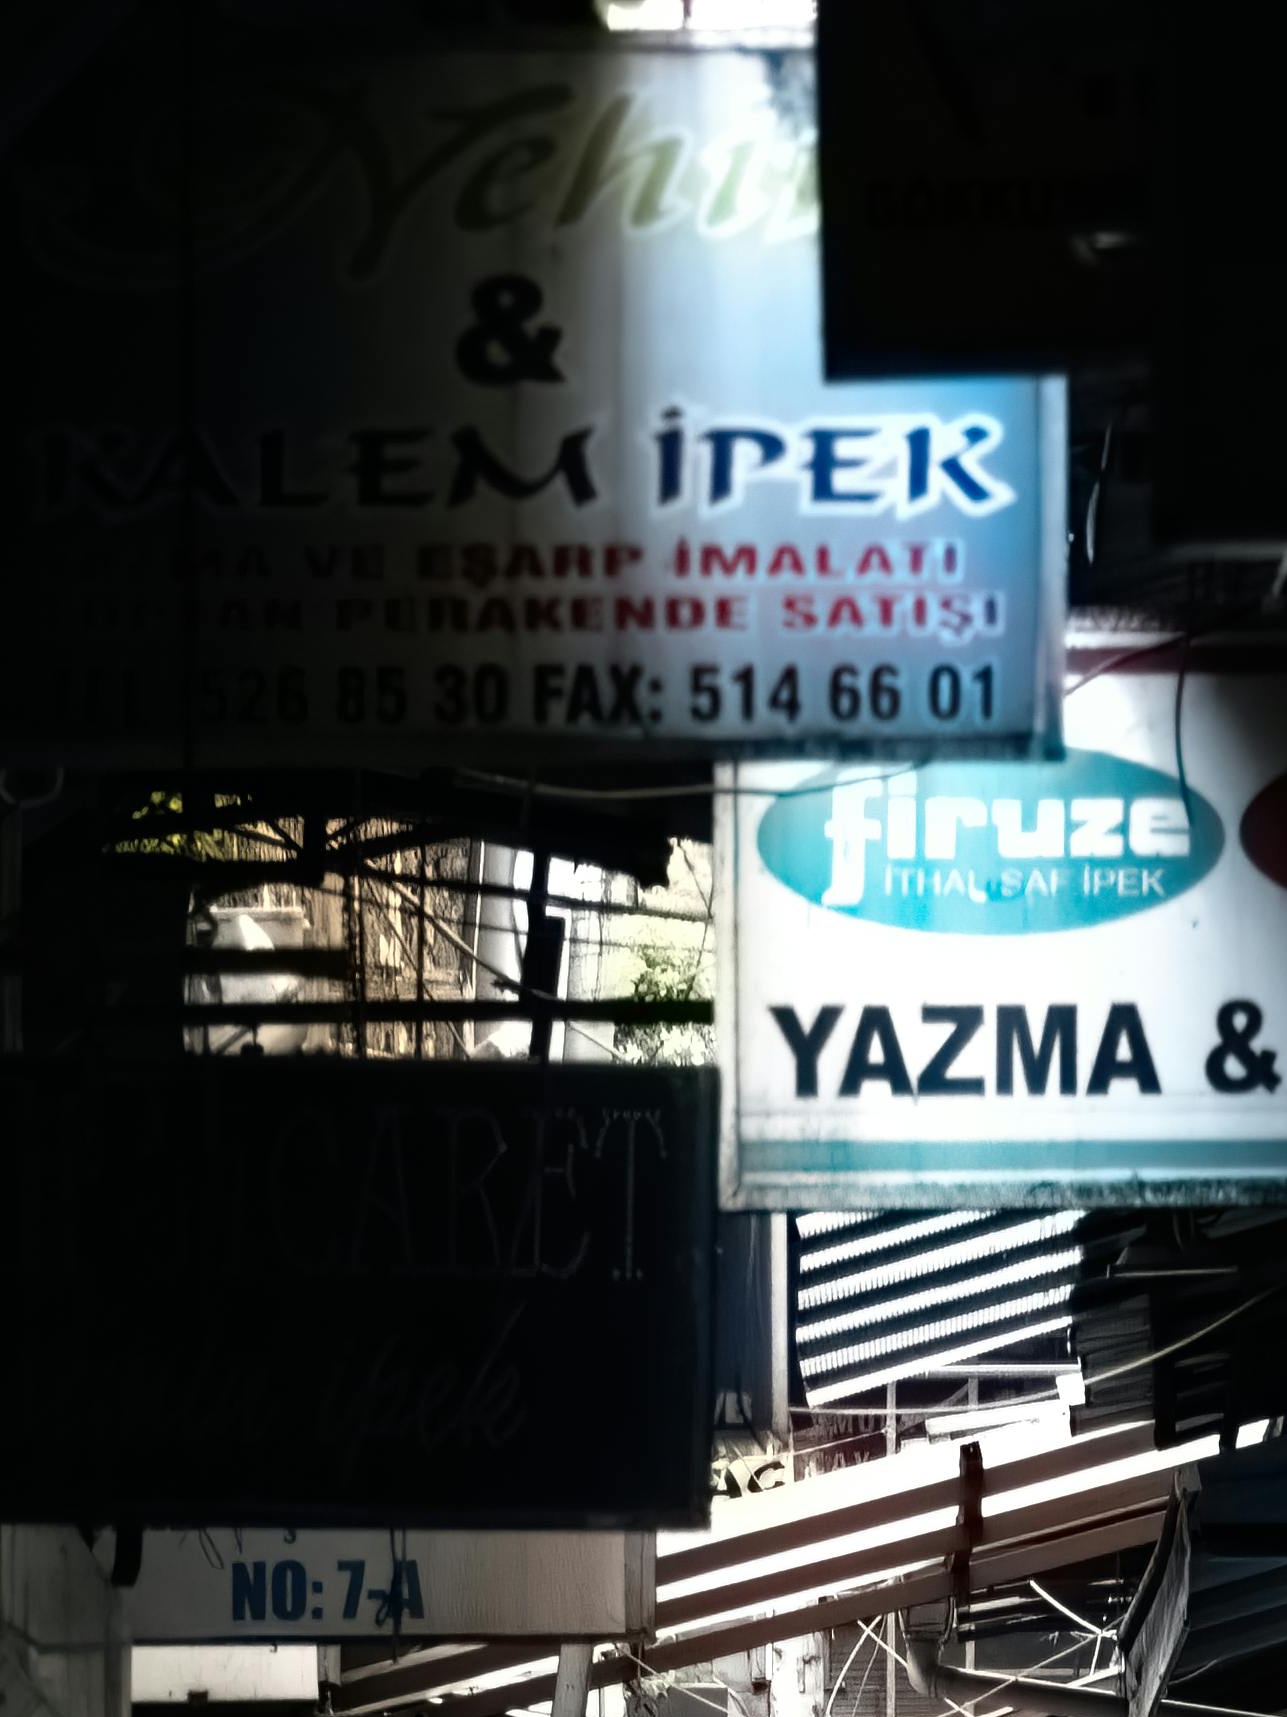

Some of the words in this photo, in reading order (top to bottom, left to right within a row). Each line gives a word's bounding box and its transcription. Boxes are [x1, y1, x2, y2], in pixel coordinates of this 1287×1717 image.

[457, 276, 564, 385] &
[417, 544, 644, 590] EŞARP
[675, 538, 961, 580] İMALATI
[336, 598, 750, 634] PERAKENDE
[783, 596, 1003, 642] SATIŞI
[337, 665, 408, 725] 85
[434, 664, 508, 725] 30
[532, 670, 665, 725] FAX:
[689, 664, 802, 723] 514
[828, 664, 903, 721] 66
[928, 662, 996, 720] 01
[821, 765, 1192, 907] firuze
[768, 1002, 1162, 1097] YAZMA
[1204, 1000, 1282, 1095] &
